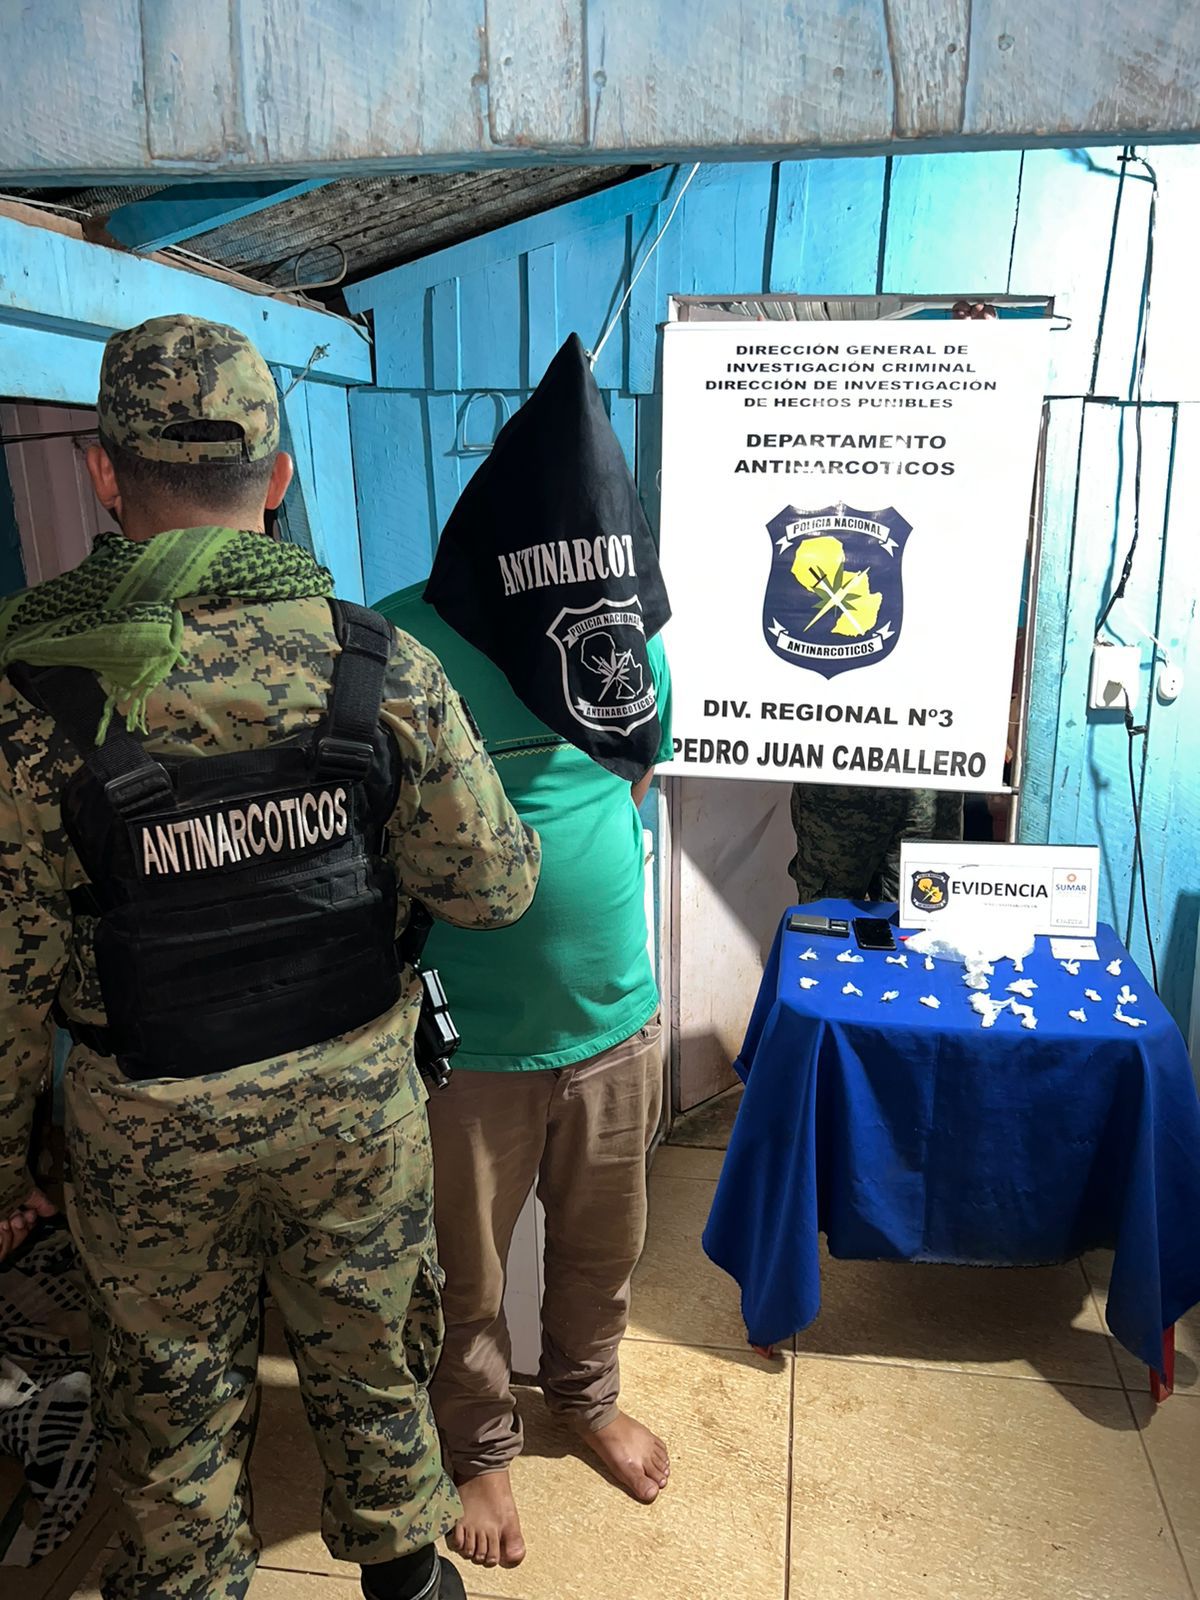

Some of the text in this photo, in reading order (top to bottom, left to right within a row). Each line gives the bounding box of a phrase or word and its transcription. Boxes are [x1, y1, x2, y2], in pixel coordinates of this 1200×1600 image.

[736, 343, 969, 355] DIRECCIÓN GENERAL DE
[726, 361, 976, 373] INVESTIGACIÓN CRIMINAL
[705, 379, 997, 391] DIRECCIÓN DE INVESTIGACIÓN
[743, 397, 953, 409] DE HECHOS PUNIBLES
[746, 433, 947, 449] DEPARTAMENTO
[793, 517, 882, 537] POLICIA NACIONAL
[570, 616, 603, 637] POLICIA
[787, 641, 875, 657] ANTINARCOTICOS
[586, 695, 654, 717] ANTINARCOTICOS
[703, 699, 751, 719] DIV.
[760, 701, 899, 725] REGIONAL
[673, 737, 987, 778] PEDRO JUAN CABALLERO
[142, 787, 348, 875] ANTINARCOTICOS
[951, 880, 1049, 898] EVIDENCIA
[1055, 883, 1087, 892] SUMAR
